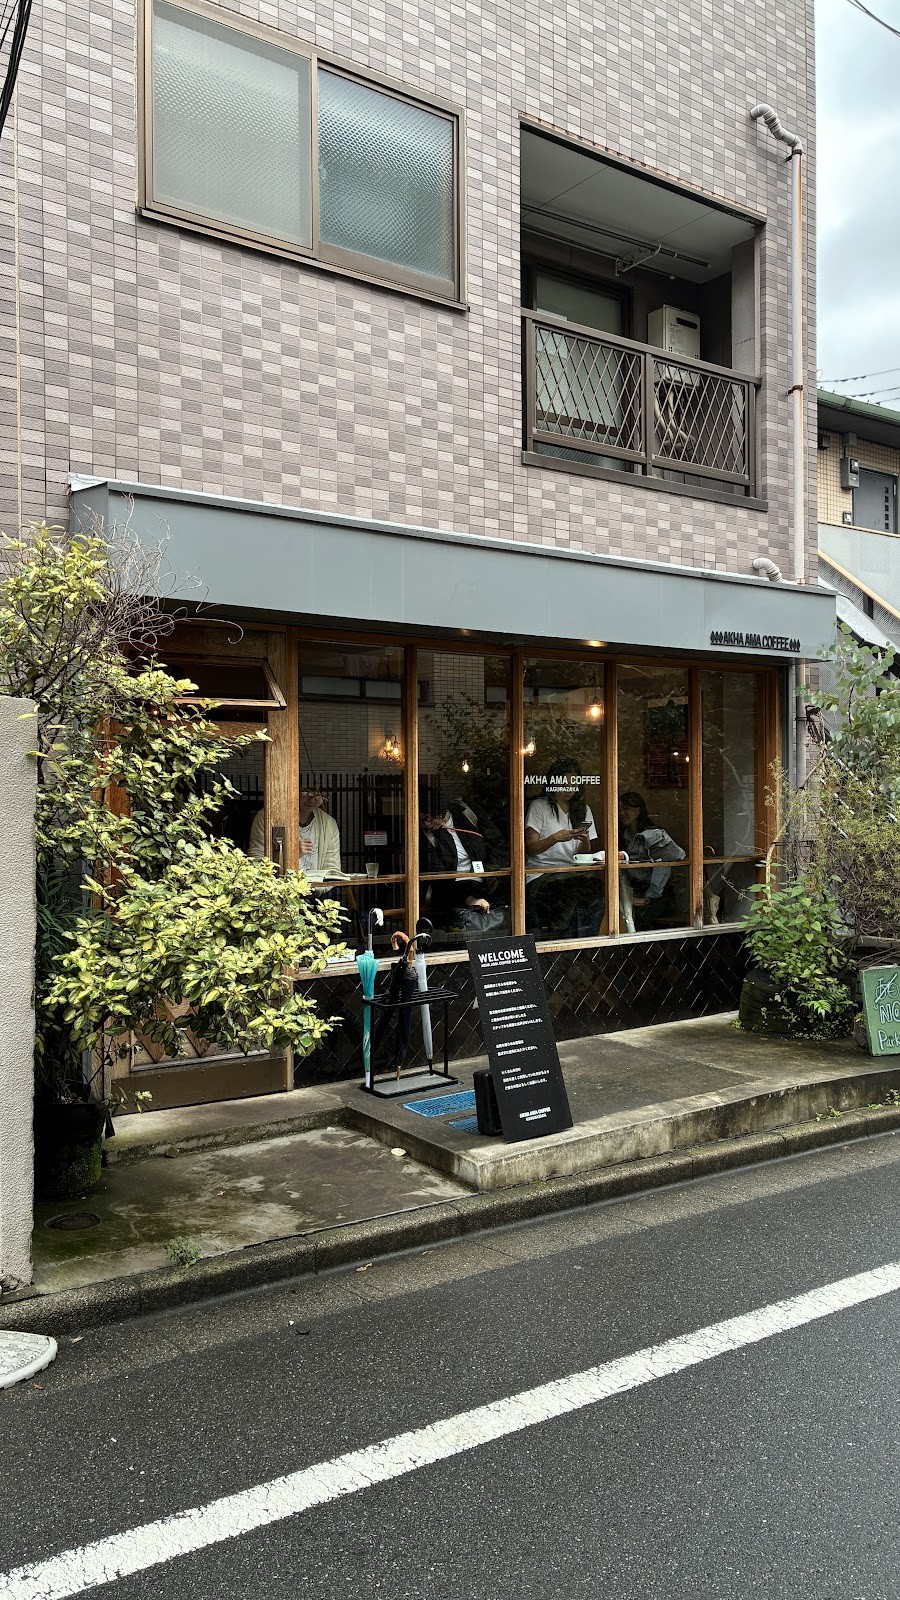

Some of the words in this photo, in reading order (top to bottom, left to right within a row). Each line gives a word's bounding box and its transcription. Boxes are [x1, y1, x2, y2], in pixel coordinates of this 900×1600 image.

[723, 631, 744, 646] AKHA
[745, 633, 761, 647] AMA
[762, 635, 789, 650] COFFEE
[524, 775, 548, 785] AKHA
[550, 775, 568, 785] AMA
[570, 775, 600, 785] COFFEE
[478, 949, 525, 963] WELCOME
